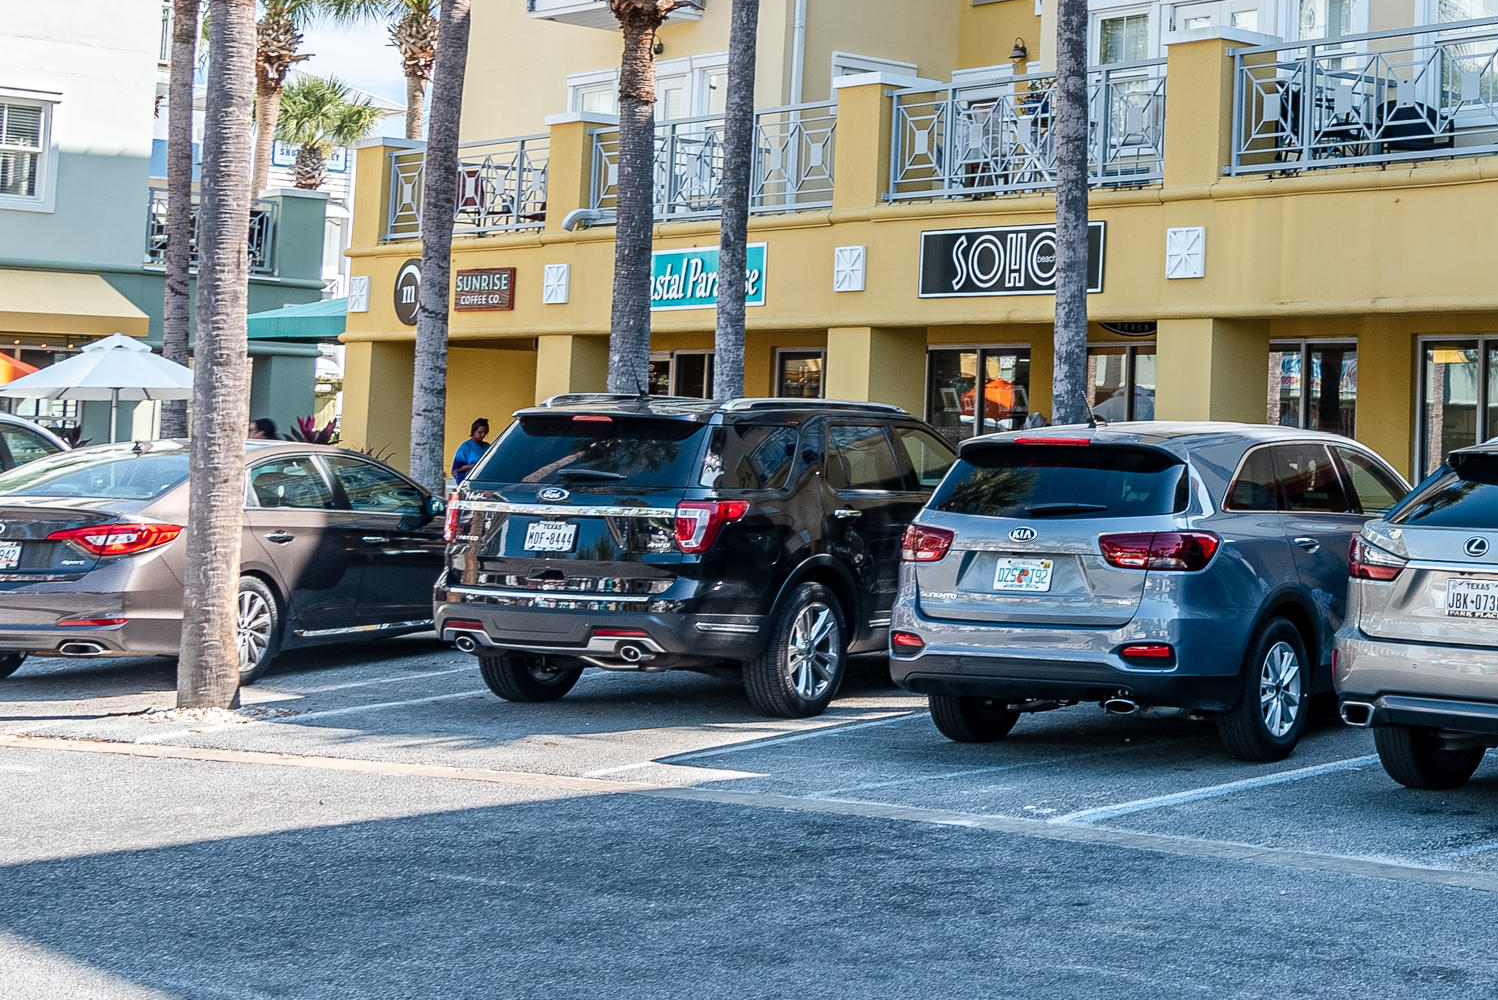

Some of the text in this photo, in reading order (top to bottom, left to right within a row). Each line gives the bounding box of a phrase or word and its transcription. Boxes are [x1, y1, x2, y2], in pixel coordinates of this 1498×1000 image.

[952, 232, 1056, 290] SOHO
[456, 273, 509, 292] SUNRISE
[460, 293, 502, 305] COFFEE CO.
[1013, 529, 1032, 539] KIA
[1466, 582, 1490, 591] TEXAS
[1449, 610, 1474, 618] PARK
